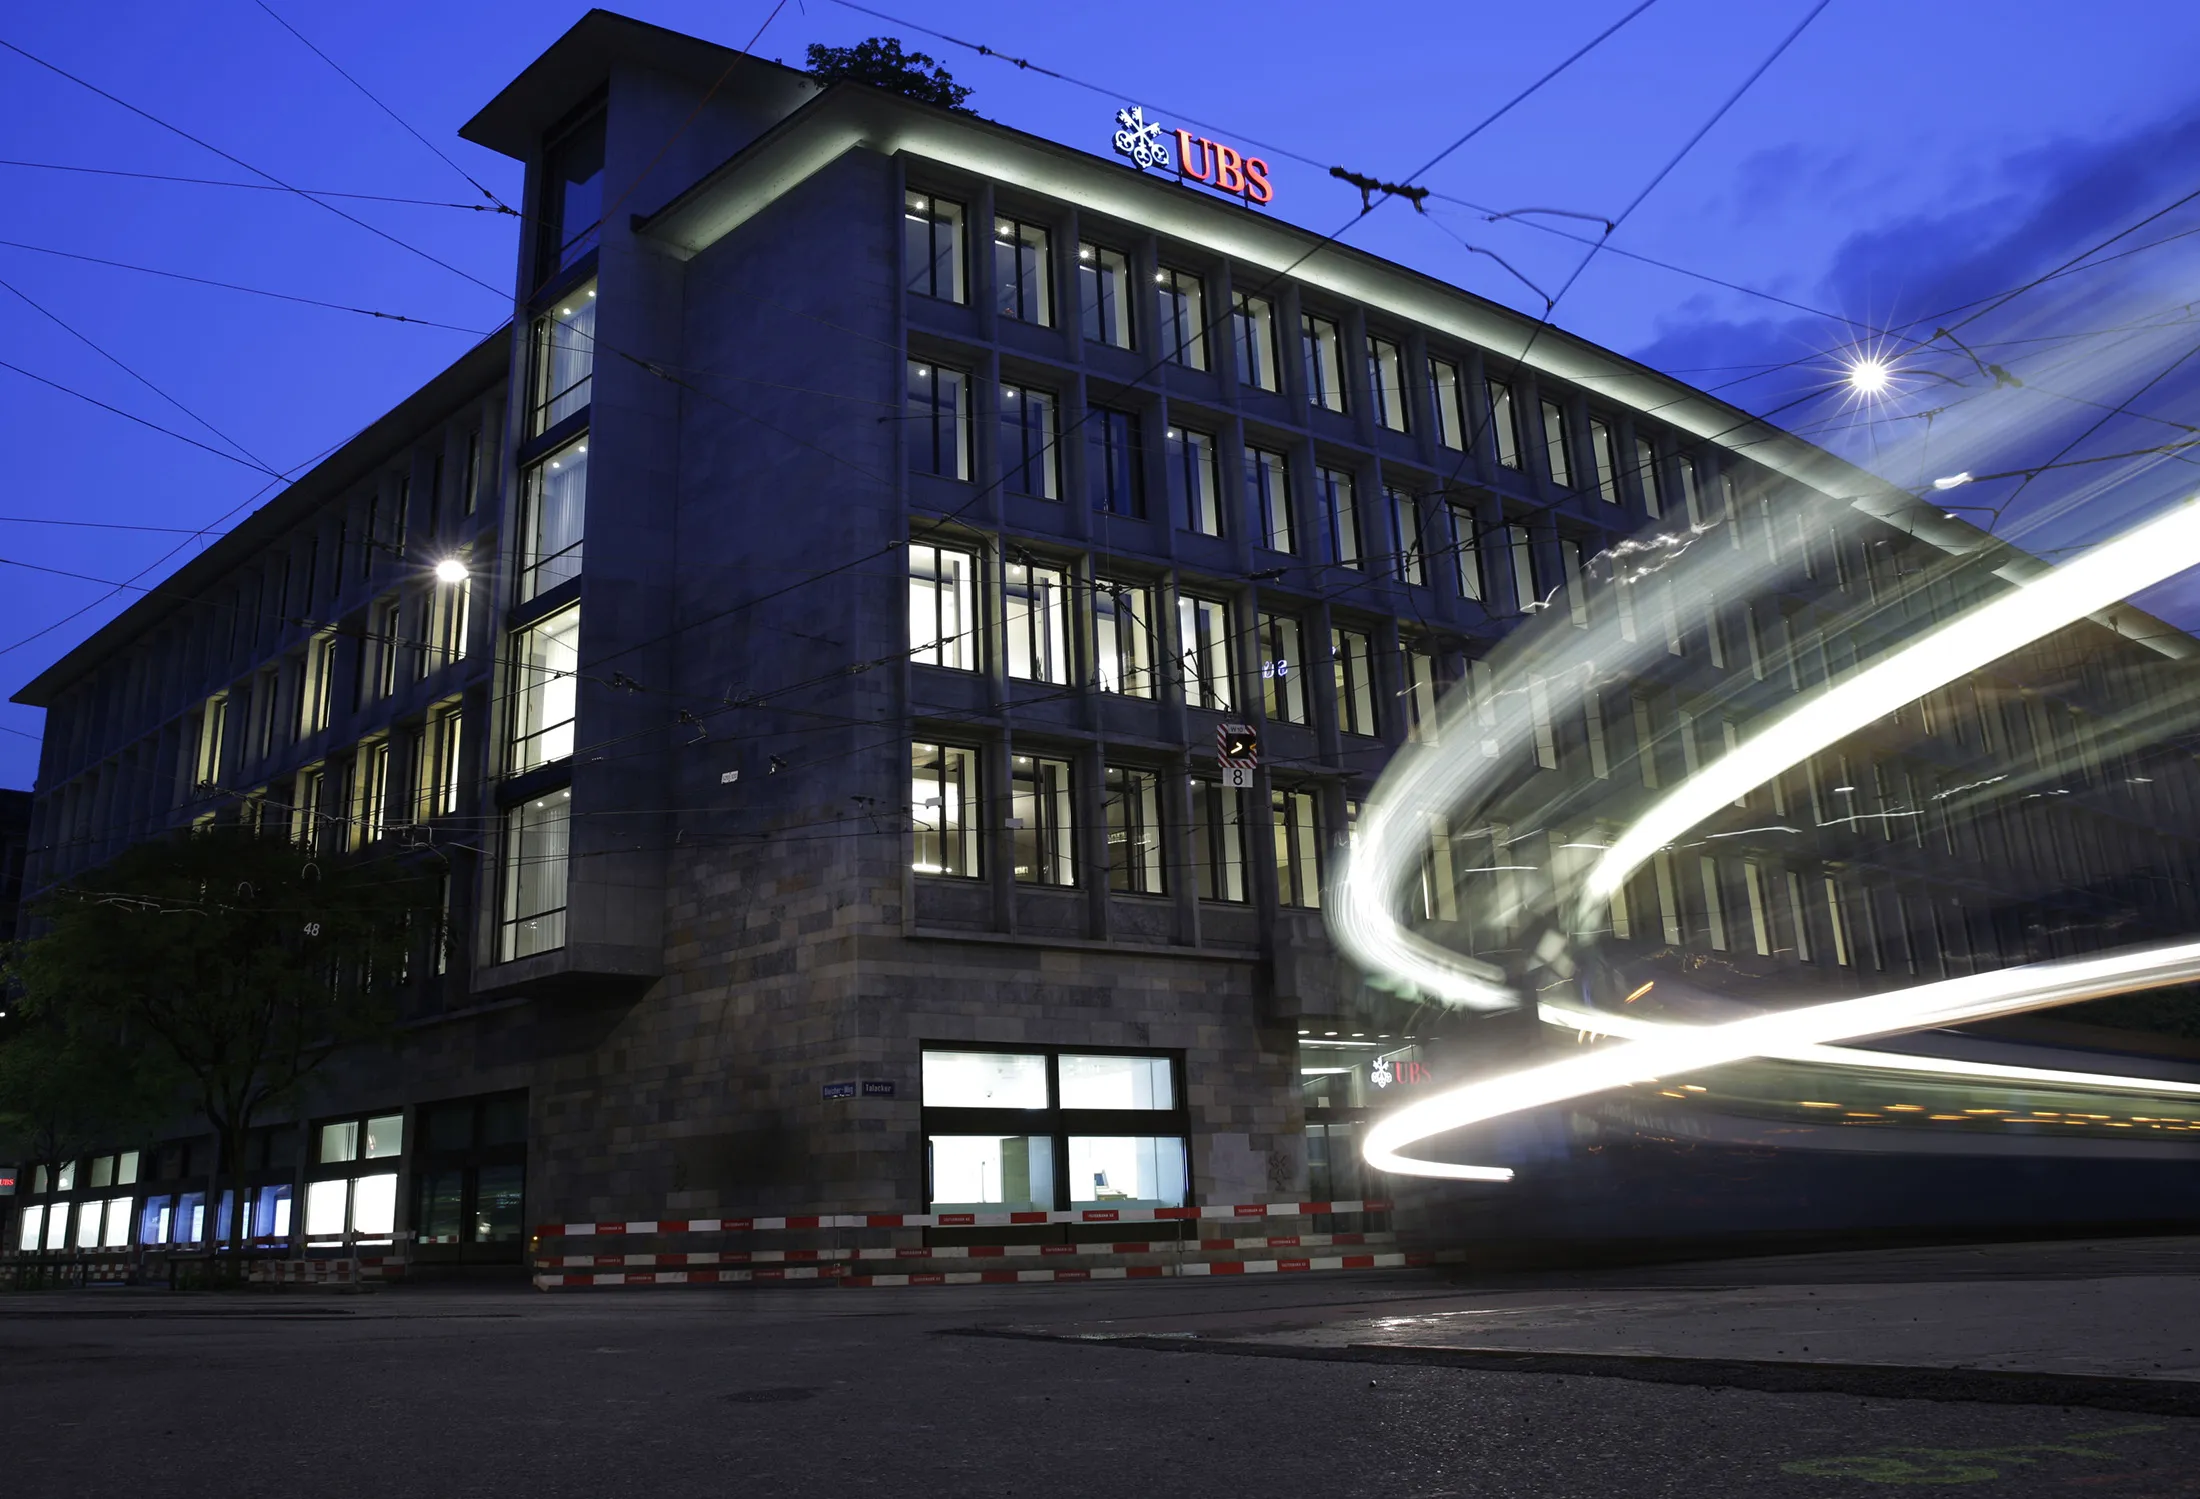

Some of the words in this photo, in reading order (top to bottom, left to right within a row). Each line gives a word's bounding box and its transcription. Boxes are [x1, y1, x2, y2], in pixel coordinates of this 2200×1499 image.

[1175, 128, 1273, 204] UBS
[1233, 769, 1243, 786] 8
[303, 922, 320, 937] 48
[1395, 1061, 1432, 1085] UBS
